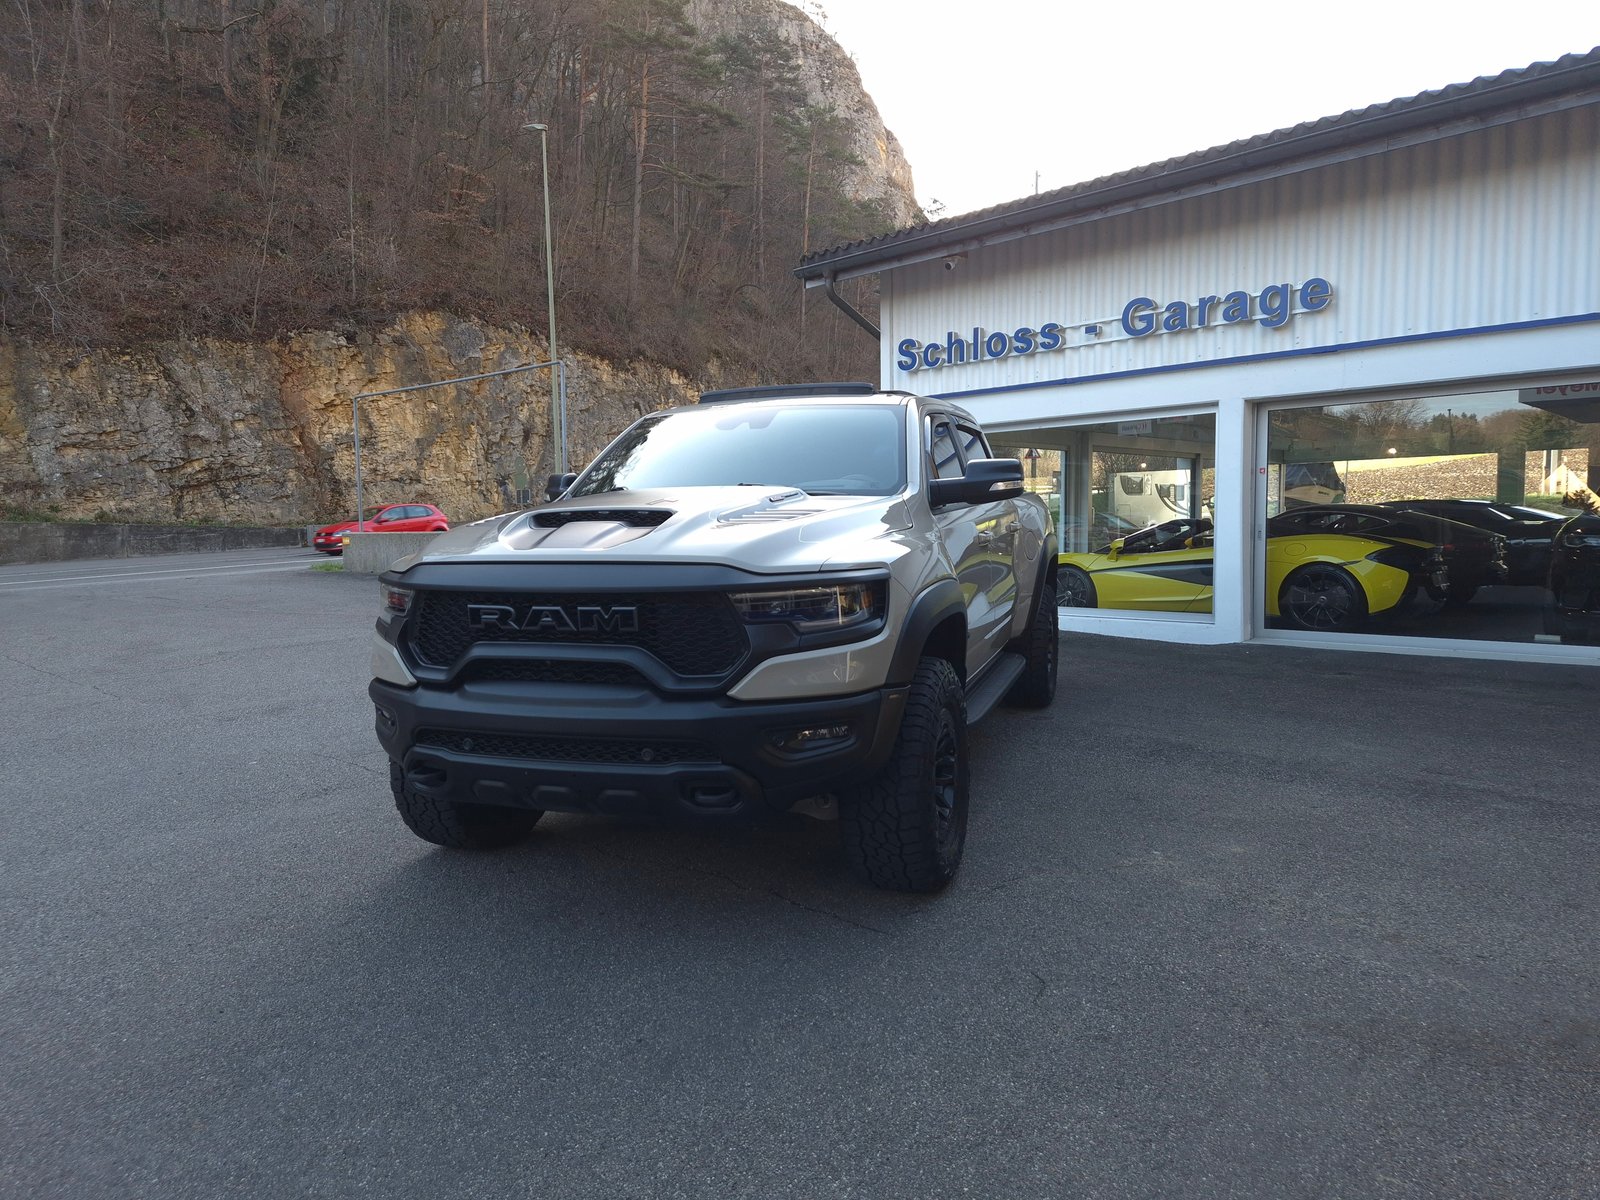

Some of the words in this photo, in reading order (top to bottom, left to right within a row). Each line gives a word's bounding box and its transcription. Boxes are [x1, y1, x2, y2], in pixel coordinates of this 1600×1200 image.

[897, 322, 1064, 373] Schloss
[1121, 276, 1334, 338] Garage
[467, 604, 639, 632] RAM
